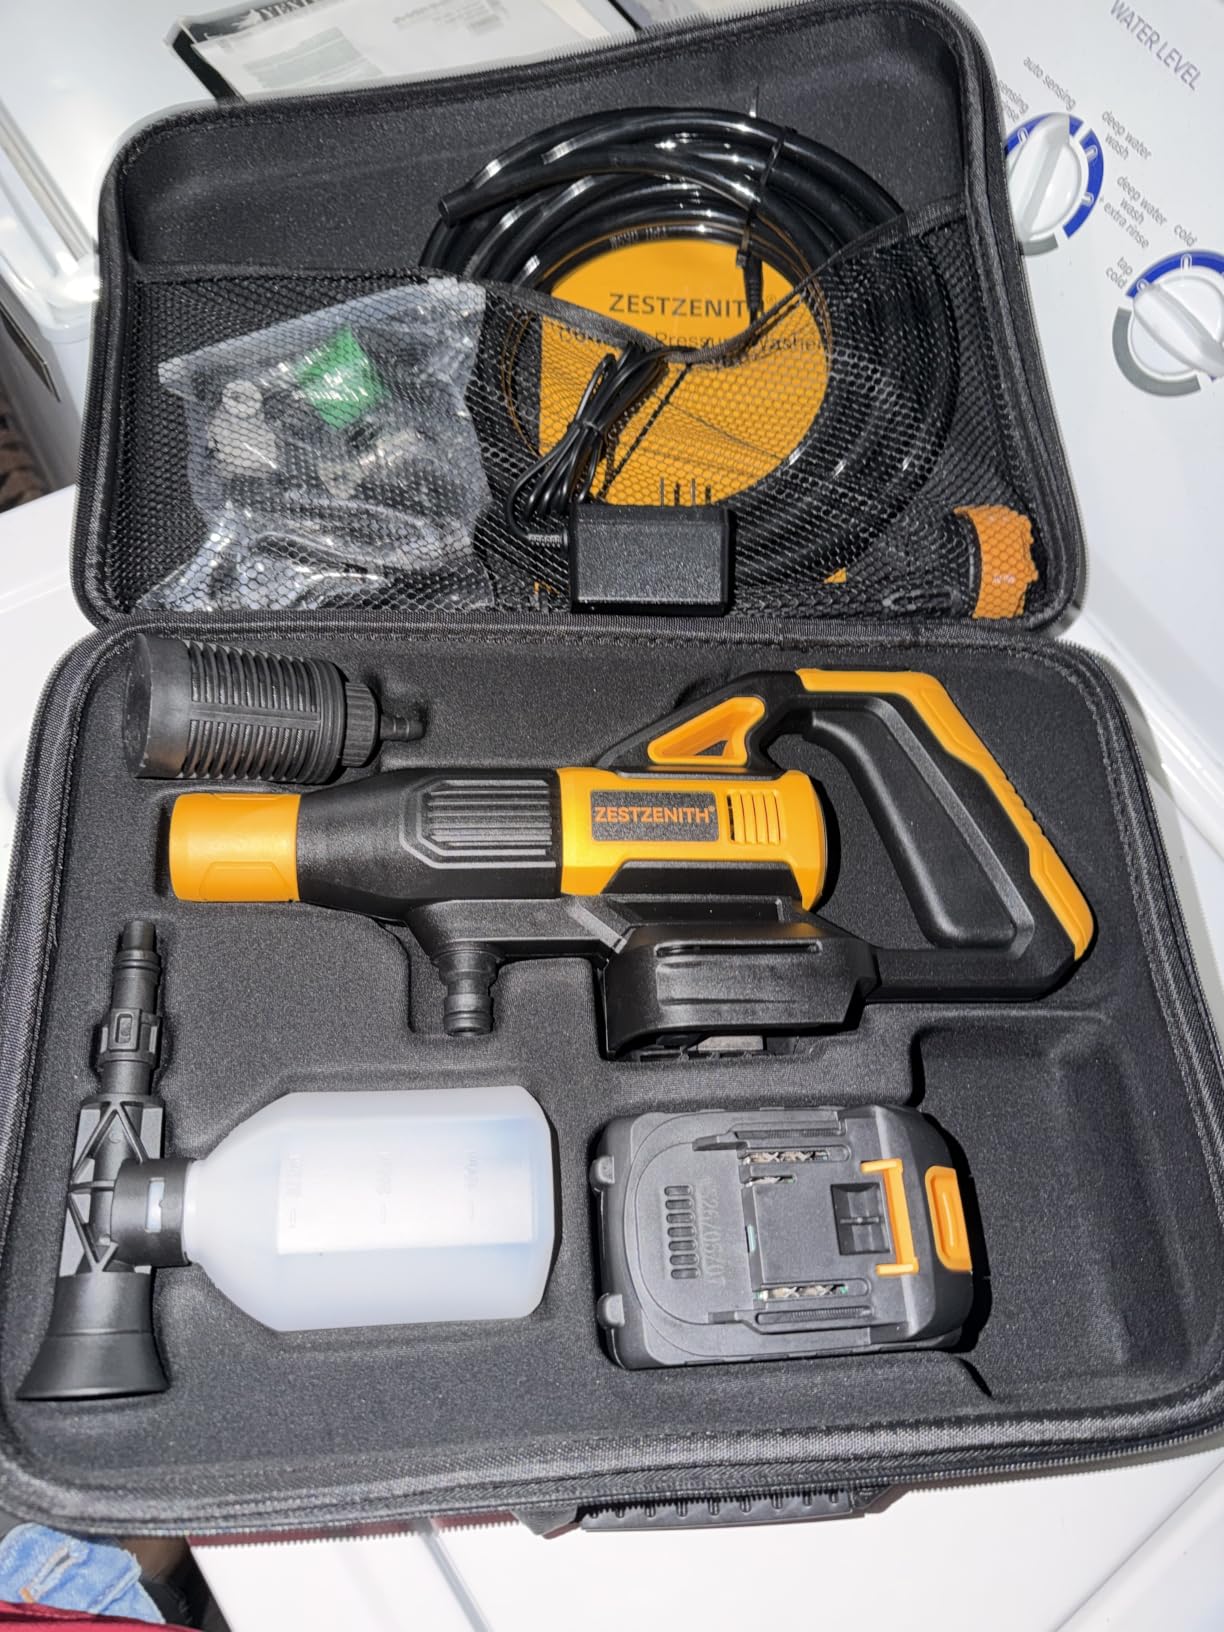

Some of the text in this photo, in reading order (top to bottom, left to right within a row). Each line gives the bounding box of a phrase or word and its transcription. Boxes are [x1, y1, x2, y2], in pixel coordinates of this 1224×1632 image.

[1110, 0, 1201, 90] WATER LEVEL
[1023, 56, 1076, 111] auto sensing
[1102, 110, 1152, 160] deep water
[1105, 133, 1129, 160] wash
[1117, 175, 1168, 227] deep water
[1120, 197, 1144, 225] wash
[1104, 202, 1150, 248] extra rinse
[1174, 223, 1198, 248] cold
[1106, 267, 1127, 289] cold
[1117, 257, 1133, 276] tap
[609, 292, 749, 319] ZESTZENIT
[595, 806, 711, 824] ZESTZENITH
